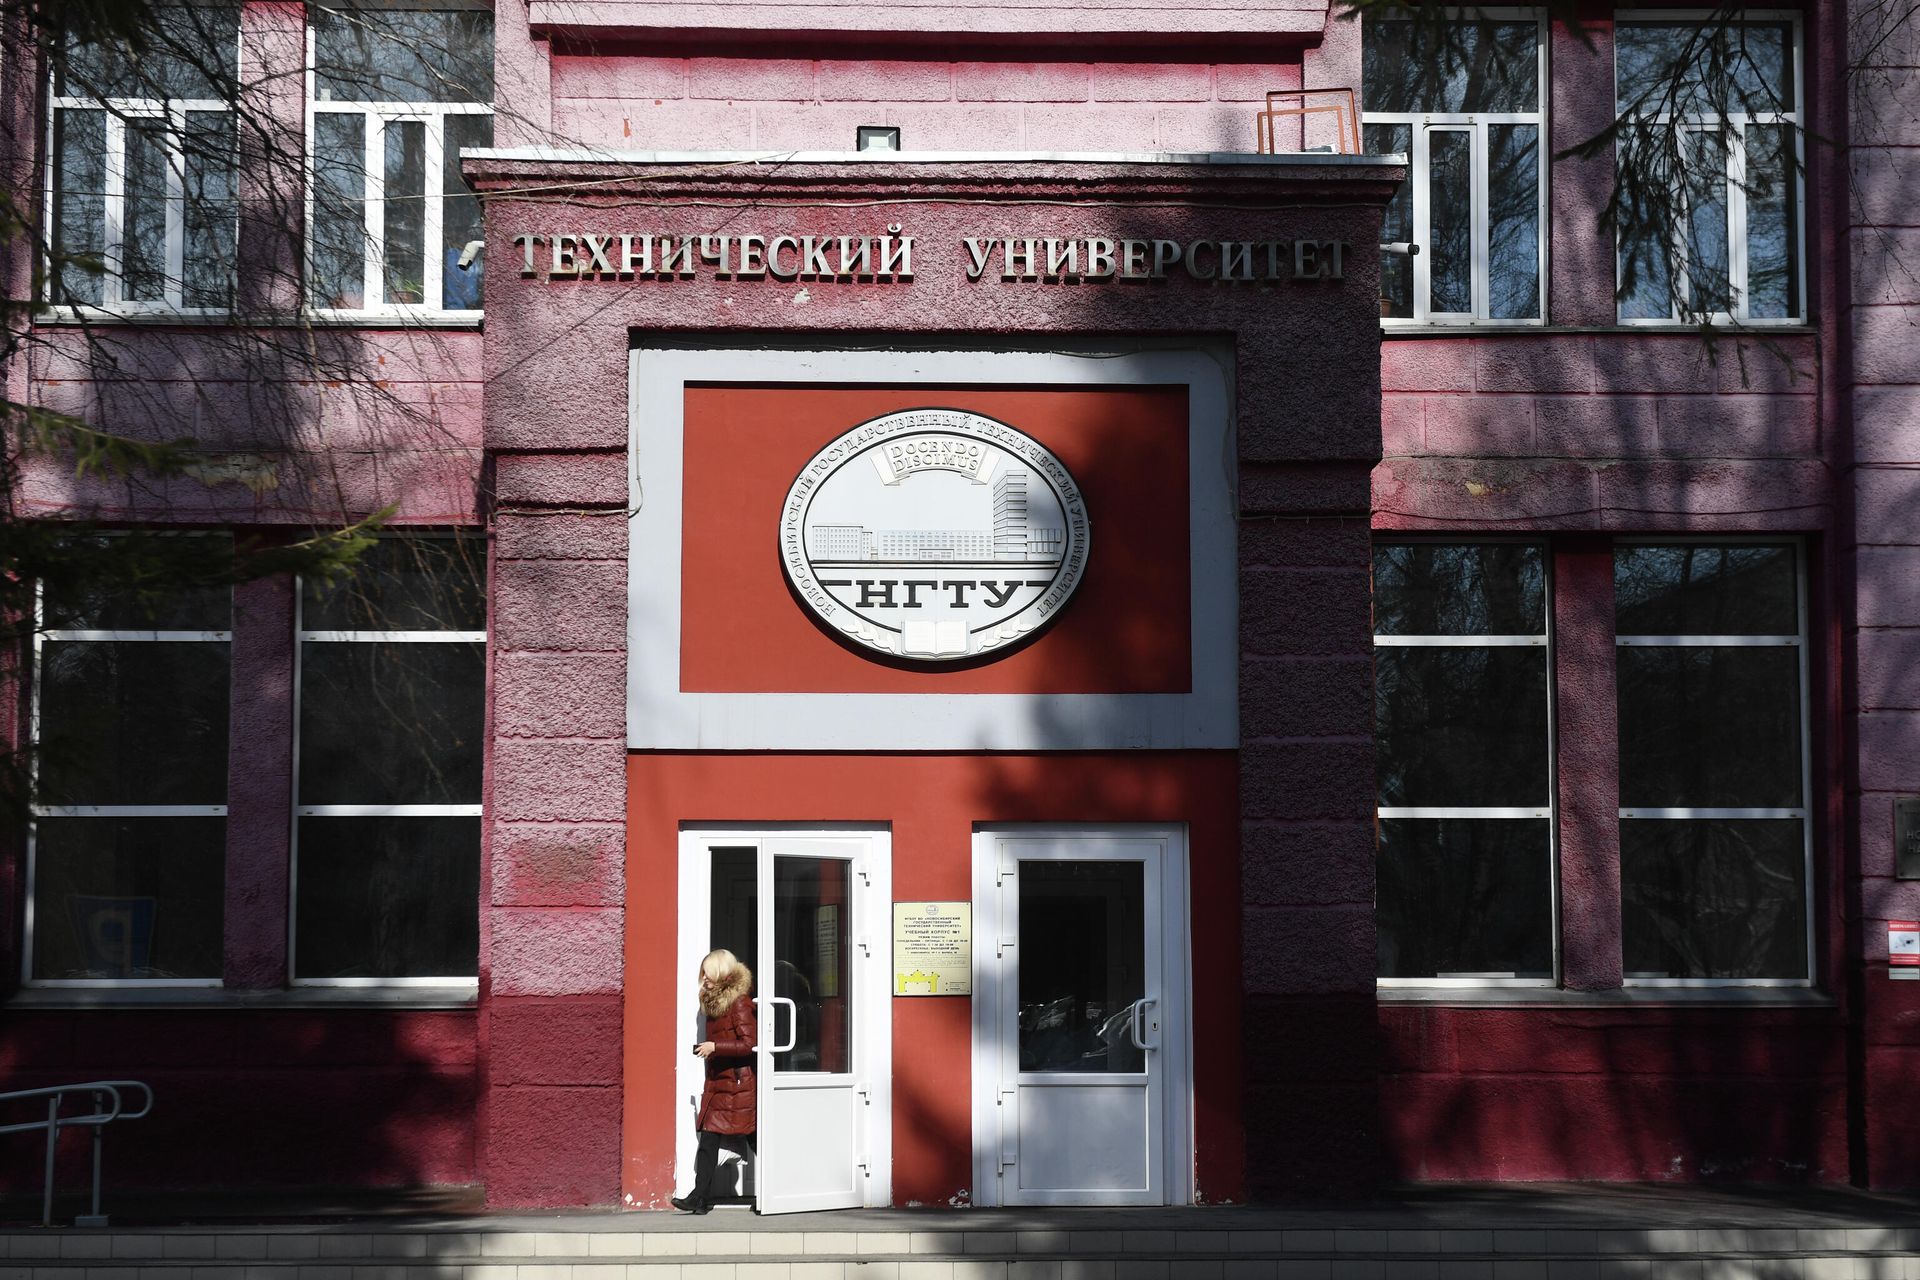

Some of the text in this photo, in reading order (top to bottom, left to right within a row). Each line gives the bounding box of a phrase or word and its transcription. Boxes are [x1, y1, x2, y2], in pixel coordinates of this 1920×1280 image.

[513, 223, 1352, 281] ТЕХНИЧЕСКИЙ УНИВЕРСИТЕТ
[890, 441, 979, 459] DOCENDO
[892, 453, 979, 472] DISCIMUS
[786, 414, 1085, 618] НОВОСИБИРСКИЙ ГОСУДАРСТВЕННЫЙ ТЕХНИЧЕСКИЙ УНИВЕРСИТЕТ
[855, 579, 1024, 608] НГТУ
